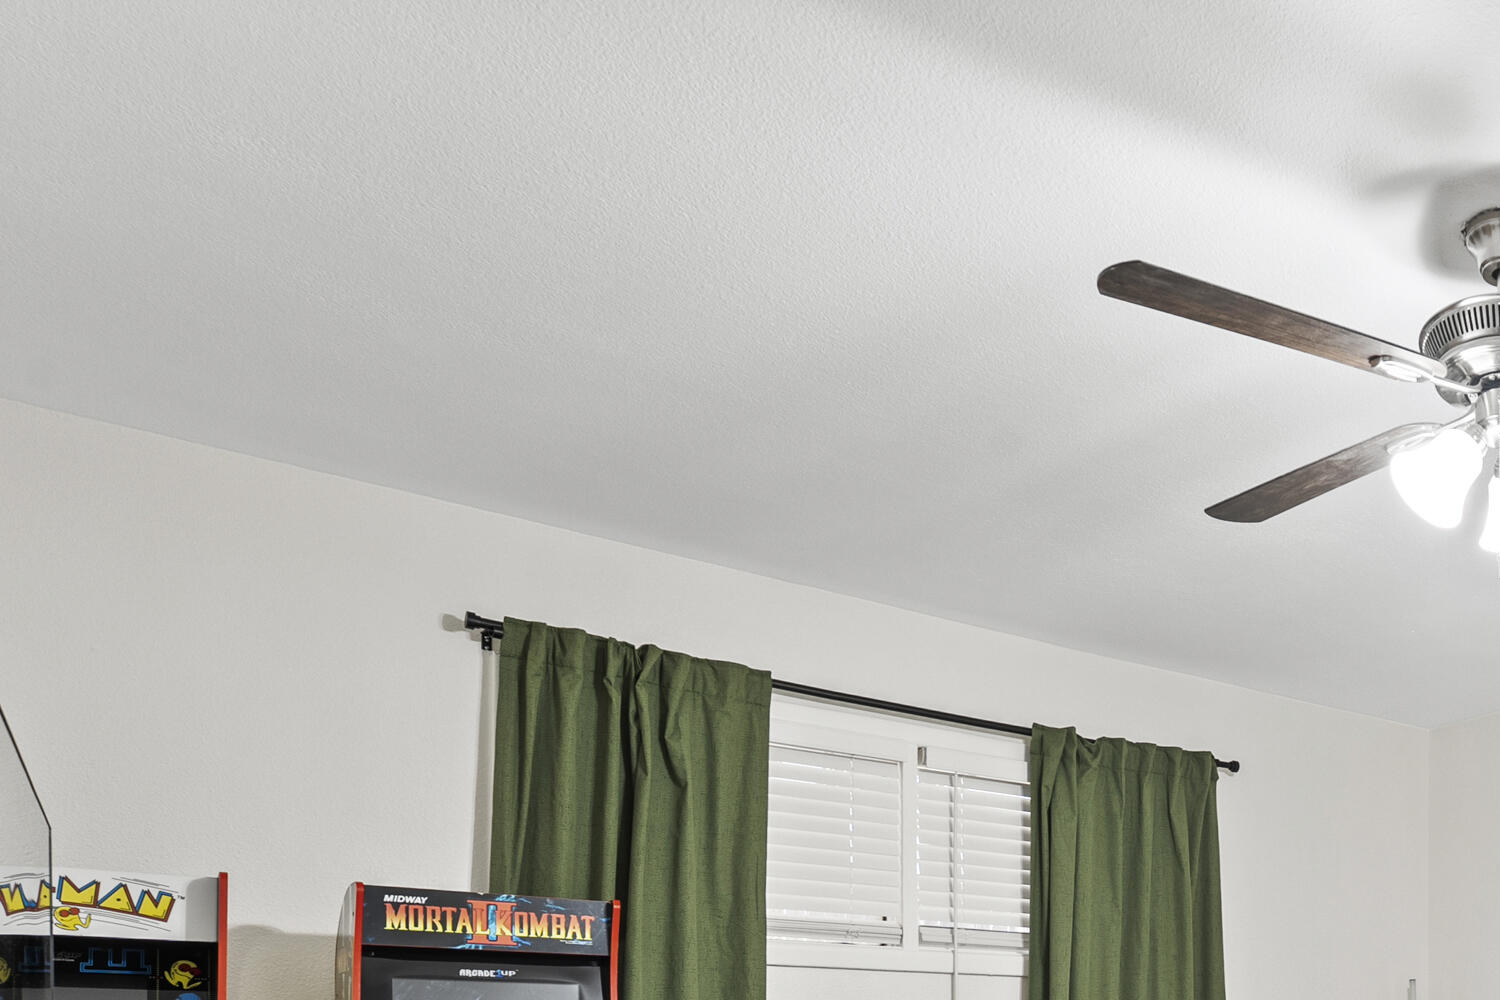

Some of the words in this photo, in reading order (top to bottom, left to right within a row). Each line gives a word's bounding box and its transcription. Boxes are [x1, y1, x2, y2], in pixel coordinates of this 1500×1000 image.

[54, 875, 176, 922] MAN
[383, 894, 428, 904] MIDWAY
[384, 903, 490, 936] MORTAL
[495, 909, 596, 940] KOMBAT
